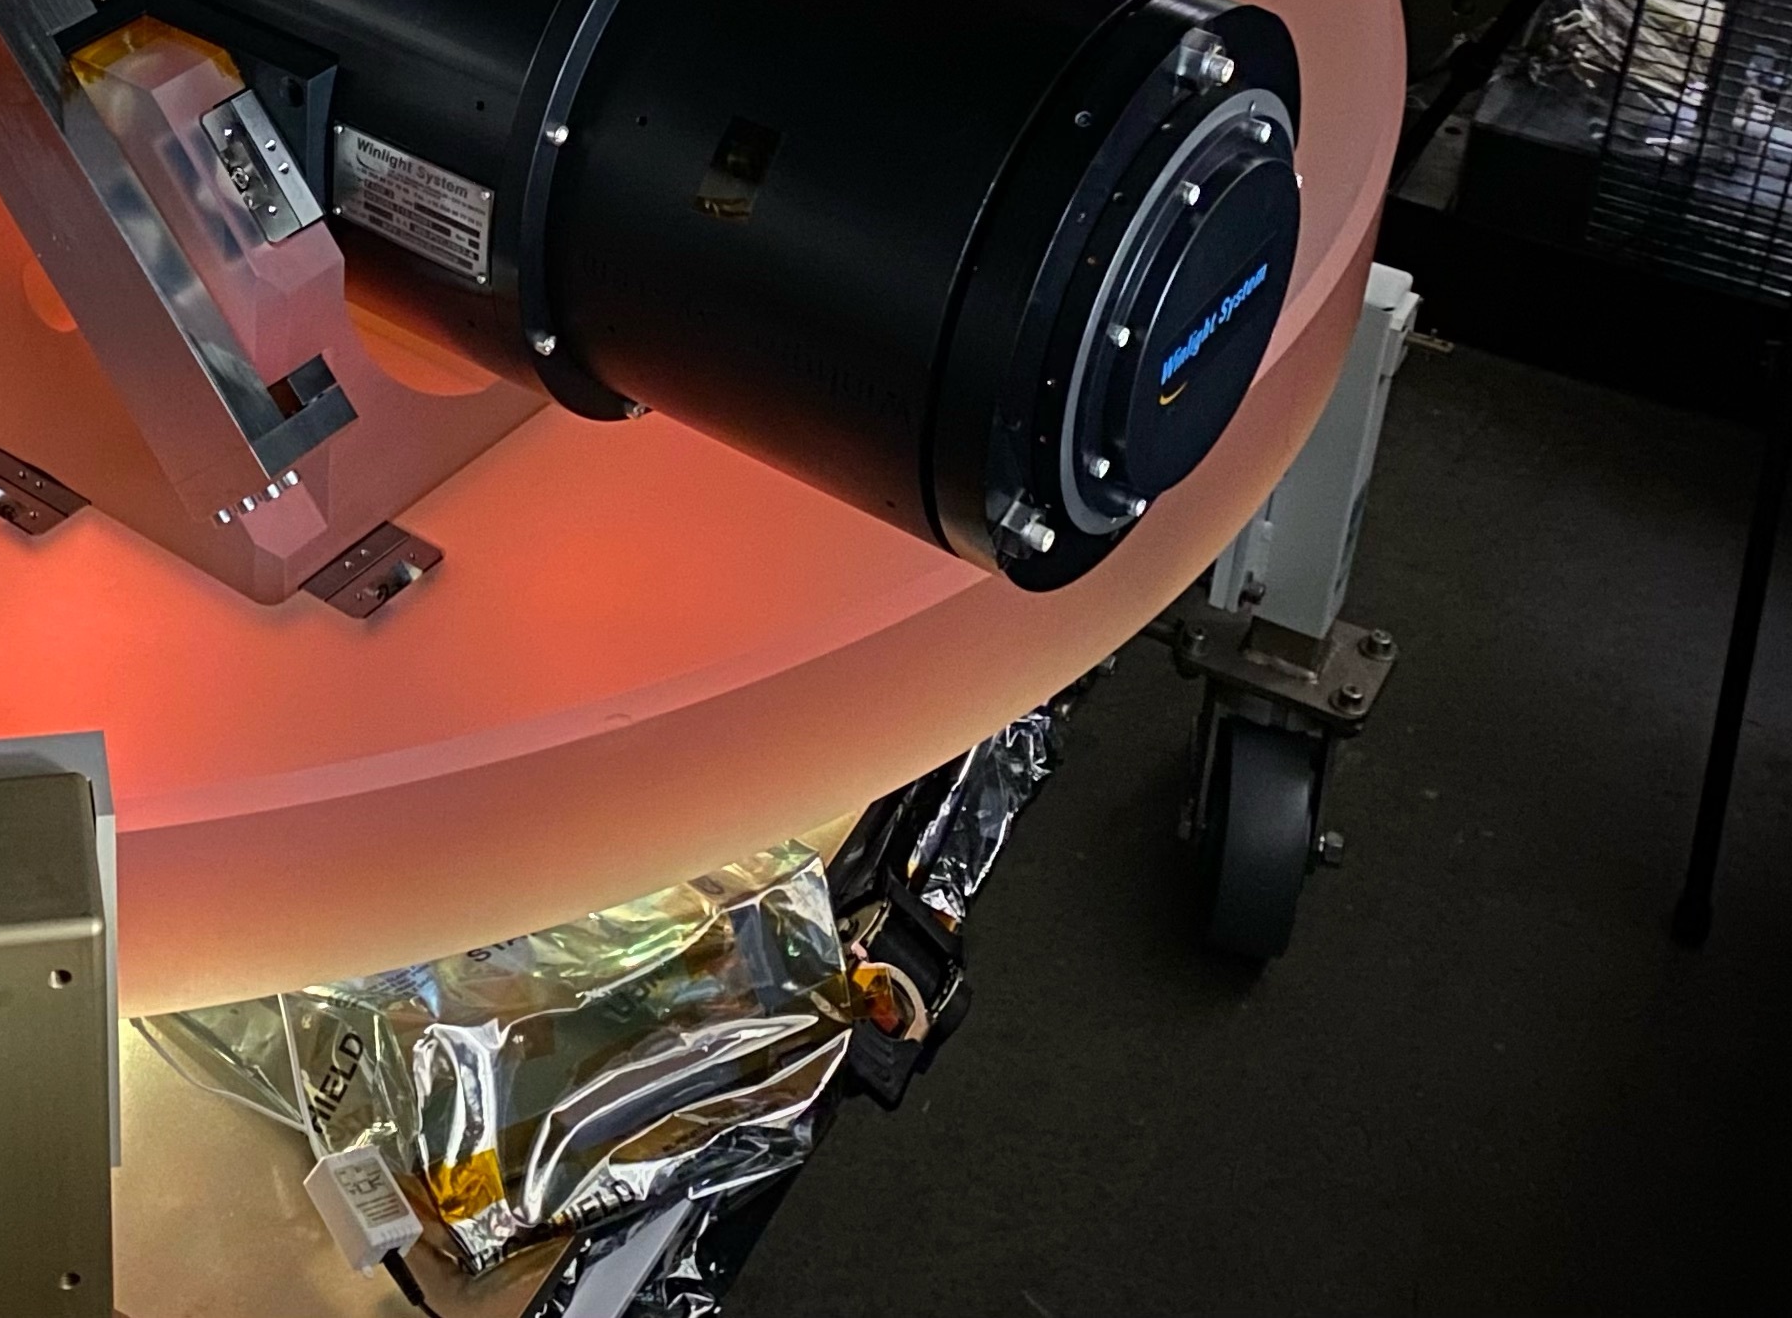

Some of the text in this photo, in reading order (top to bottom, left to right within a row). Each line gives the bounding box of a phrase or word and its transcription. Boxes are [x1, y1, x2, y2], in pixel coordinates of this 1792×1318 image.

[357, 137, 413, 174] Winlight
[417, 165, 469, 200] System
[1160, 263, 1268, 386] Winlight System
